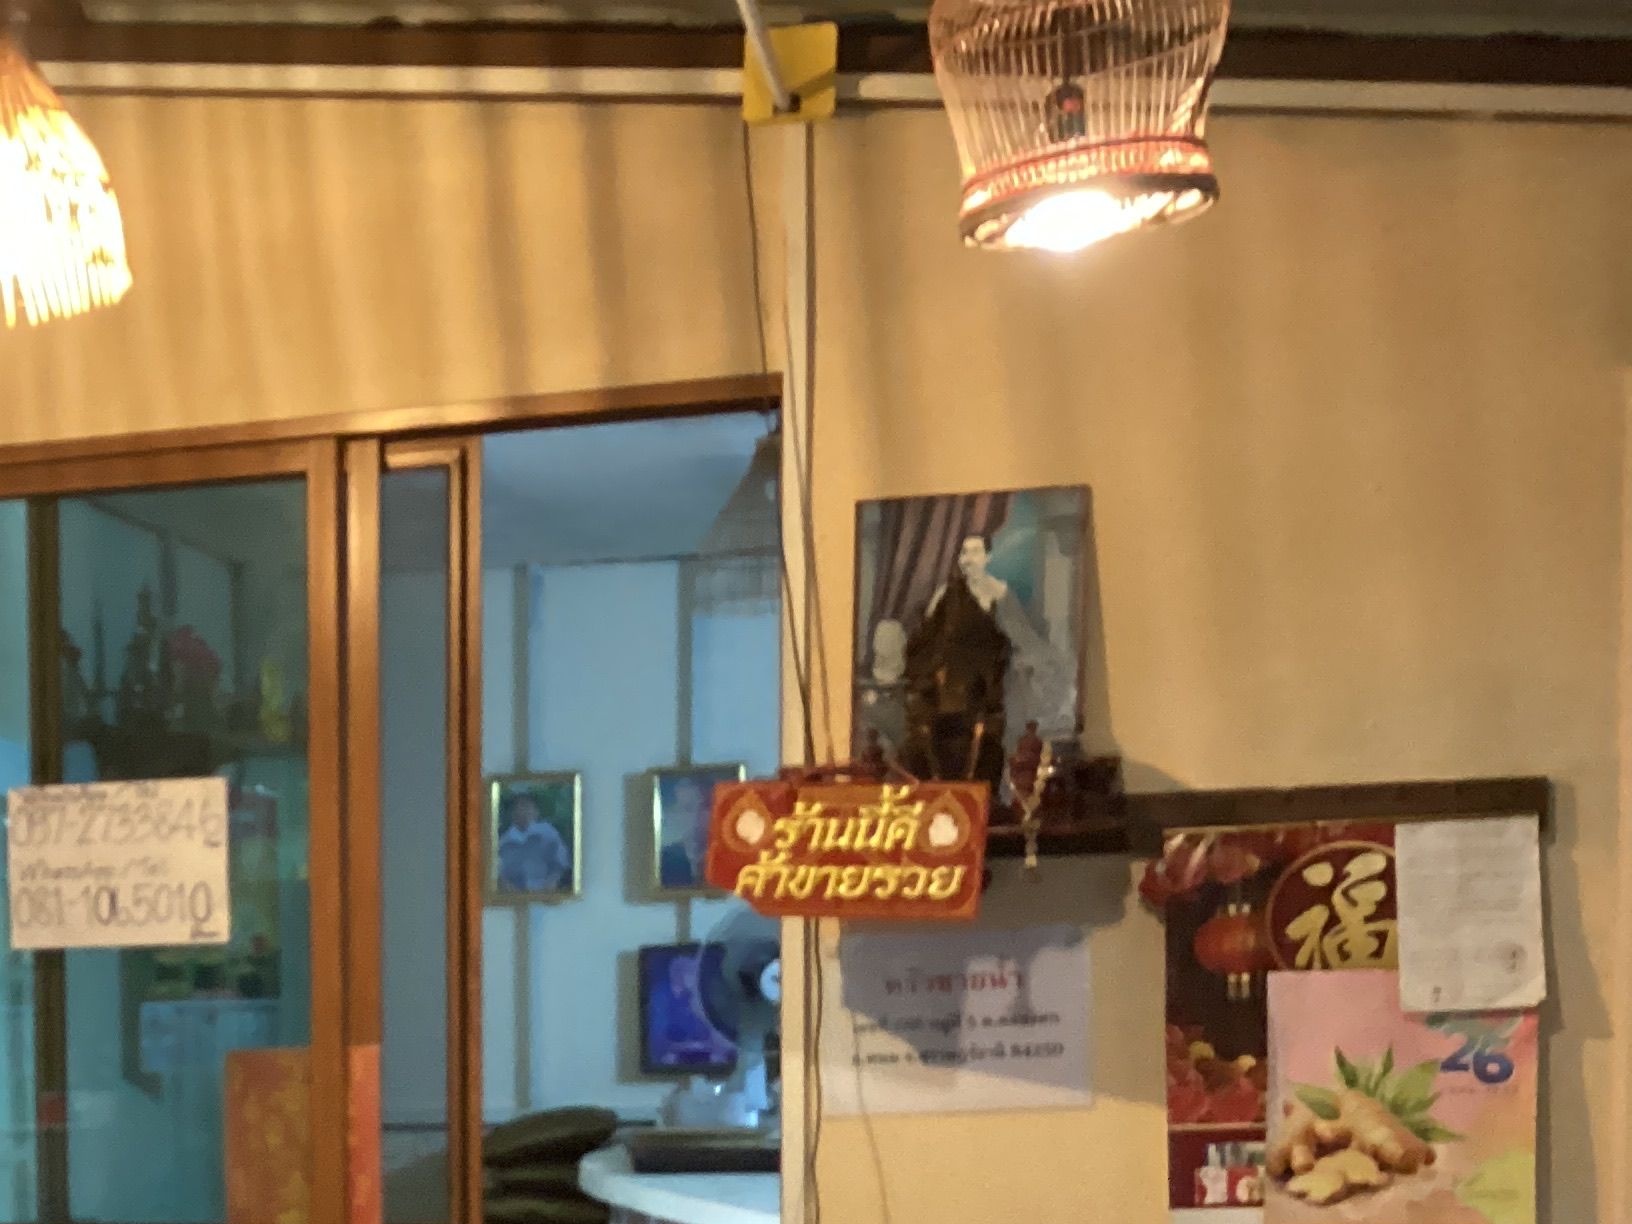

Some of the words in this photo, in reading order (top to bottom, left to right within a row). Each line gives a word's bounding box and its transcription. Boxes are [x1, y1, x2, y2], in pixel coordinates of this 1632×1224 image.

[773, 784, 927, 851] ร้านนี้ดี
[735, 849, 968, 900] ค้าขายรวย
